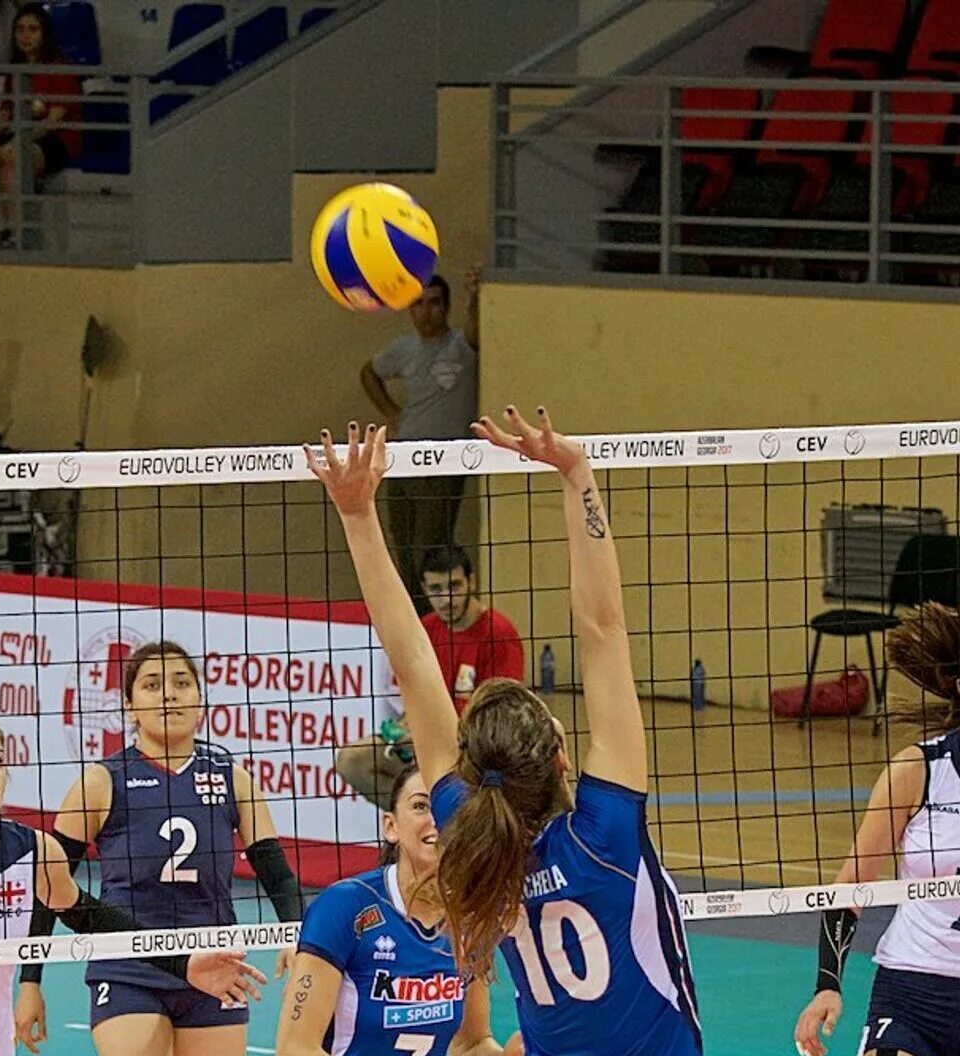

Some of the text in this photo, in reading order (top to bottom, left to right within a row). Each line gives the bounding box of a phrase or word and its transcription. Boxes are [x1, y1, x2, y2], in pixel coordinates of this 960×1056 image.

[625, 440, 685, 457] WOMEN
[796, 436, 828, 452] CEV
[119, 456, 224, 476] EUROVOLLEY
[230, 453, 293, 471] WOMEN
[412, 450, 445, 466] CEV
[5, 462, 39, 479] CEV
[205, 652, 363, 697] GEORGIAN
[158, 816, 200, 883] 2
[805, 891, 837, 908] CEV
[132, 930, 237, 952] EUROVOLLEY
[18, 944, 52, 960] CEV
[507, 899, 610, 1006] 10
[297, 974, 312, 989] 13
[373, 971, 463, 1002] Kinder
[96, 982, 109, 1006] 2
[291, 1005, 301, 1021] 5
[406, 1003, 449, 1022] SPORT
[876, 1018, 893, 1039] 7
